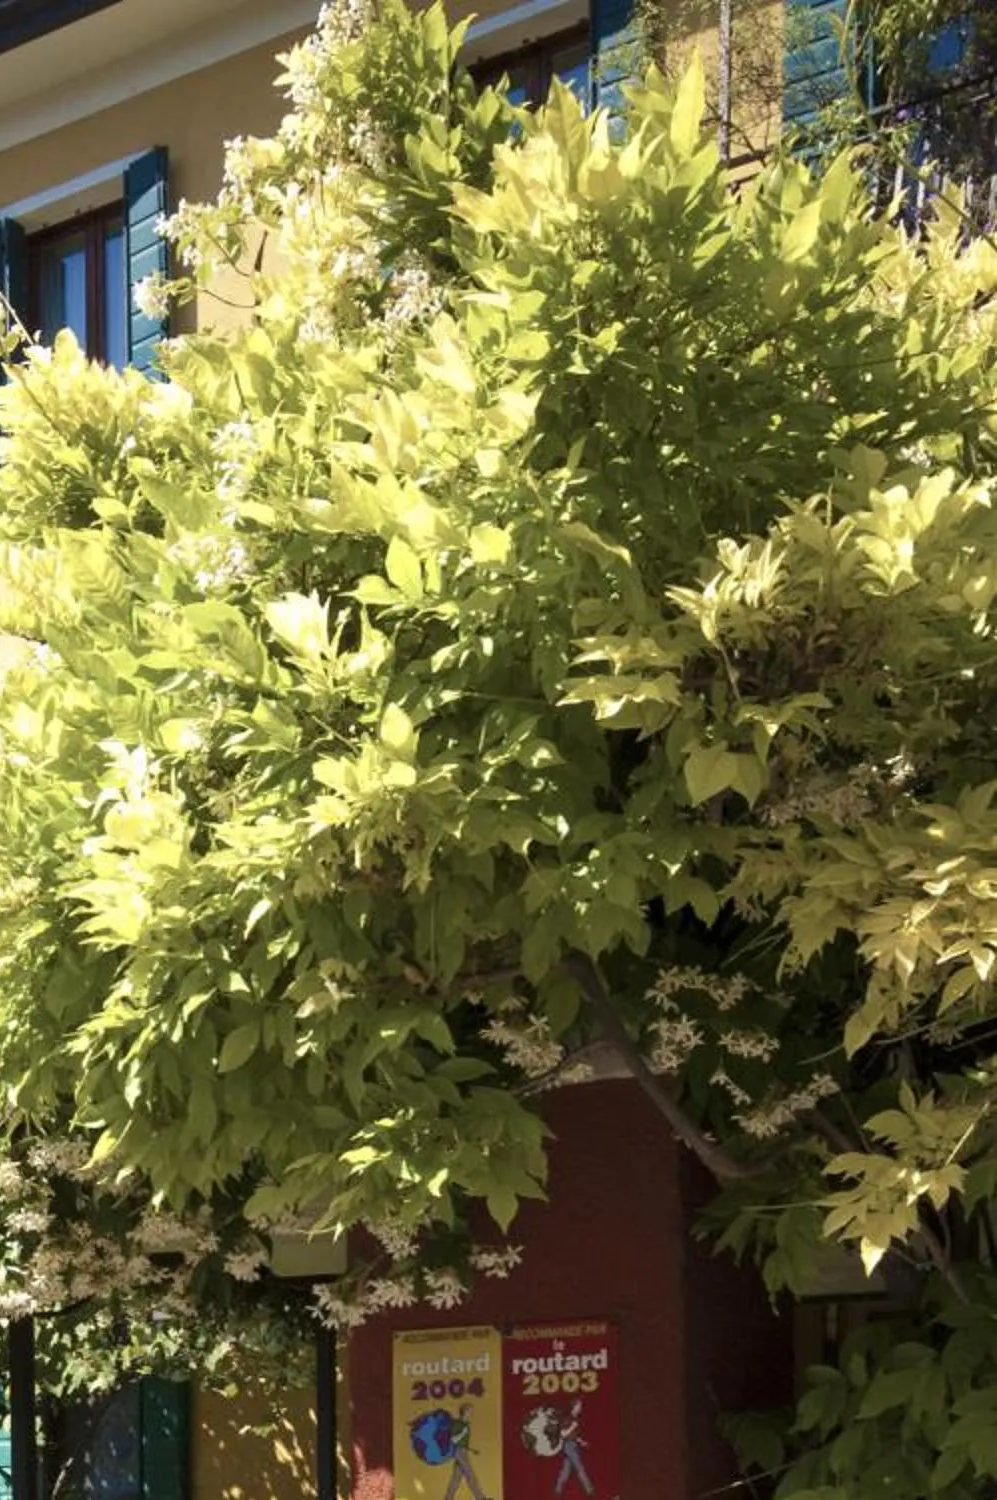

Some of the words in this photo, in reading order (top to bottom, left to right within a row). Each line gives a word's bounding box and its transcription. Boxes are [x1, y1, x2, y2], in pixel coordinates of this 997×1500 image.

[403, 1352, 490, 1376] routard
[512, 1349, 608, 1374] routard
[410, 1378, 485, 1401] 2004
[522, 1371, 600, 1395] 2003
